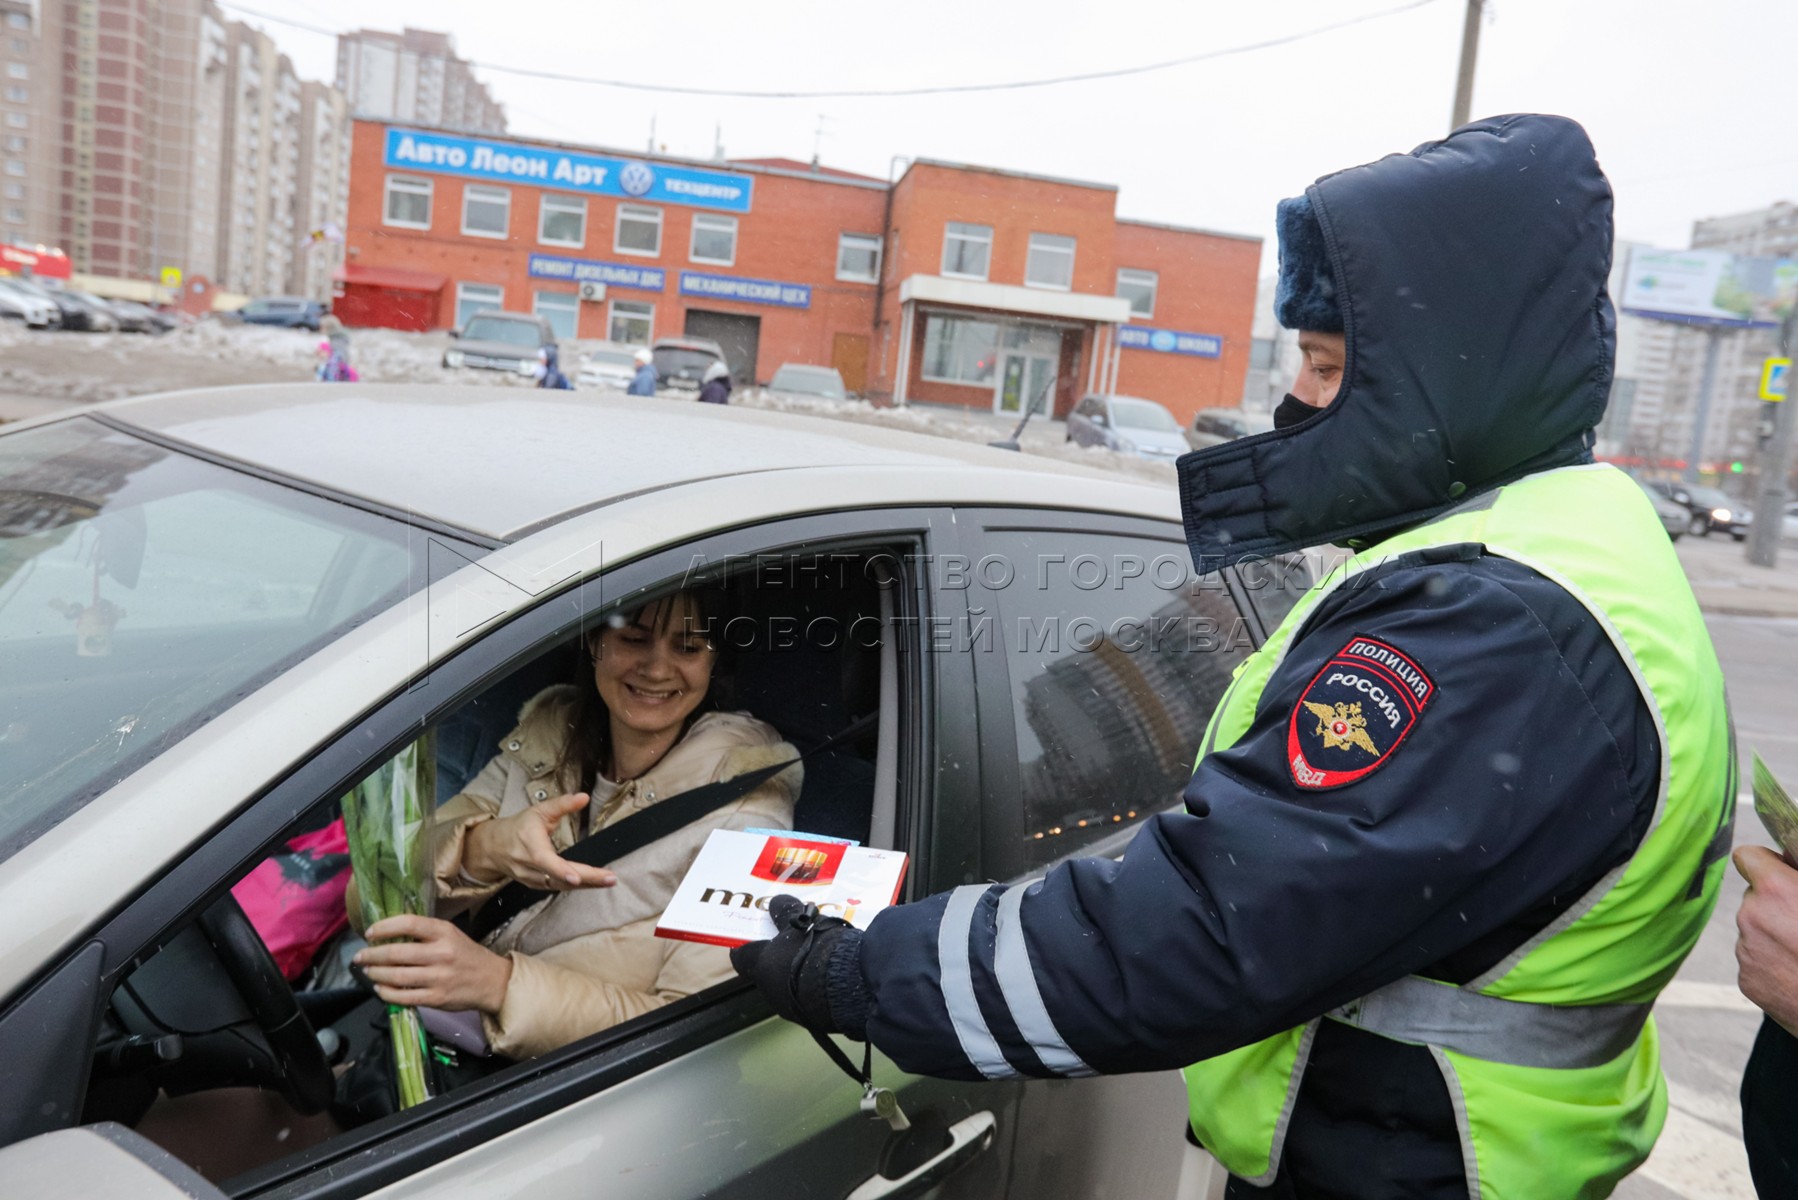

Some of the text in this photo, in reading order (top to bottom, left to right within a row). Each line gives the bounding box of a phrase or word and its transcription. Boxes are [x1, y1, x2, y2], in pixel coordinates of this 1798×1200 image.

[395, 136, 608, 185] Авто Леон Арт
[531, 258, 574, 276] РЕМОНТ
[573, 263, 639, 284] ДИЗЕЛЬНЫХ
[683, 275, 781, 301] МЕХАНИЧЕСКИЙ
[1349, 642, 1428, 698] ПОЛИЦИЯ
[1326, 673, 1401, 729] РОССИЯ
[1292, 753, 1327, 785] МВД
